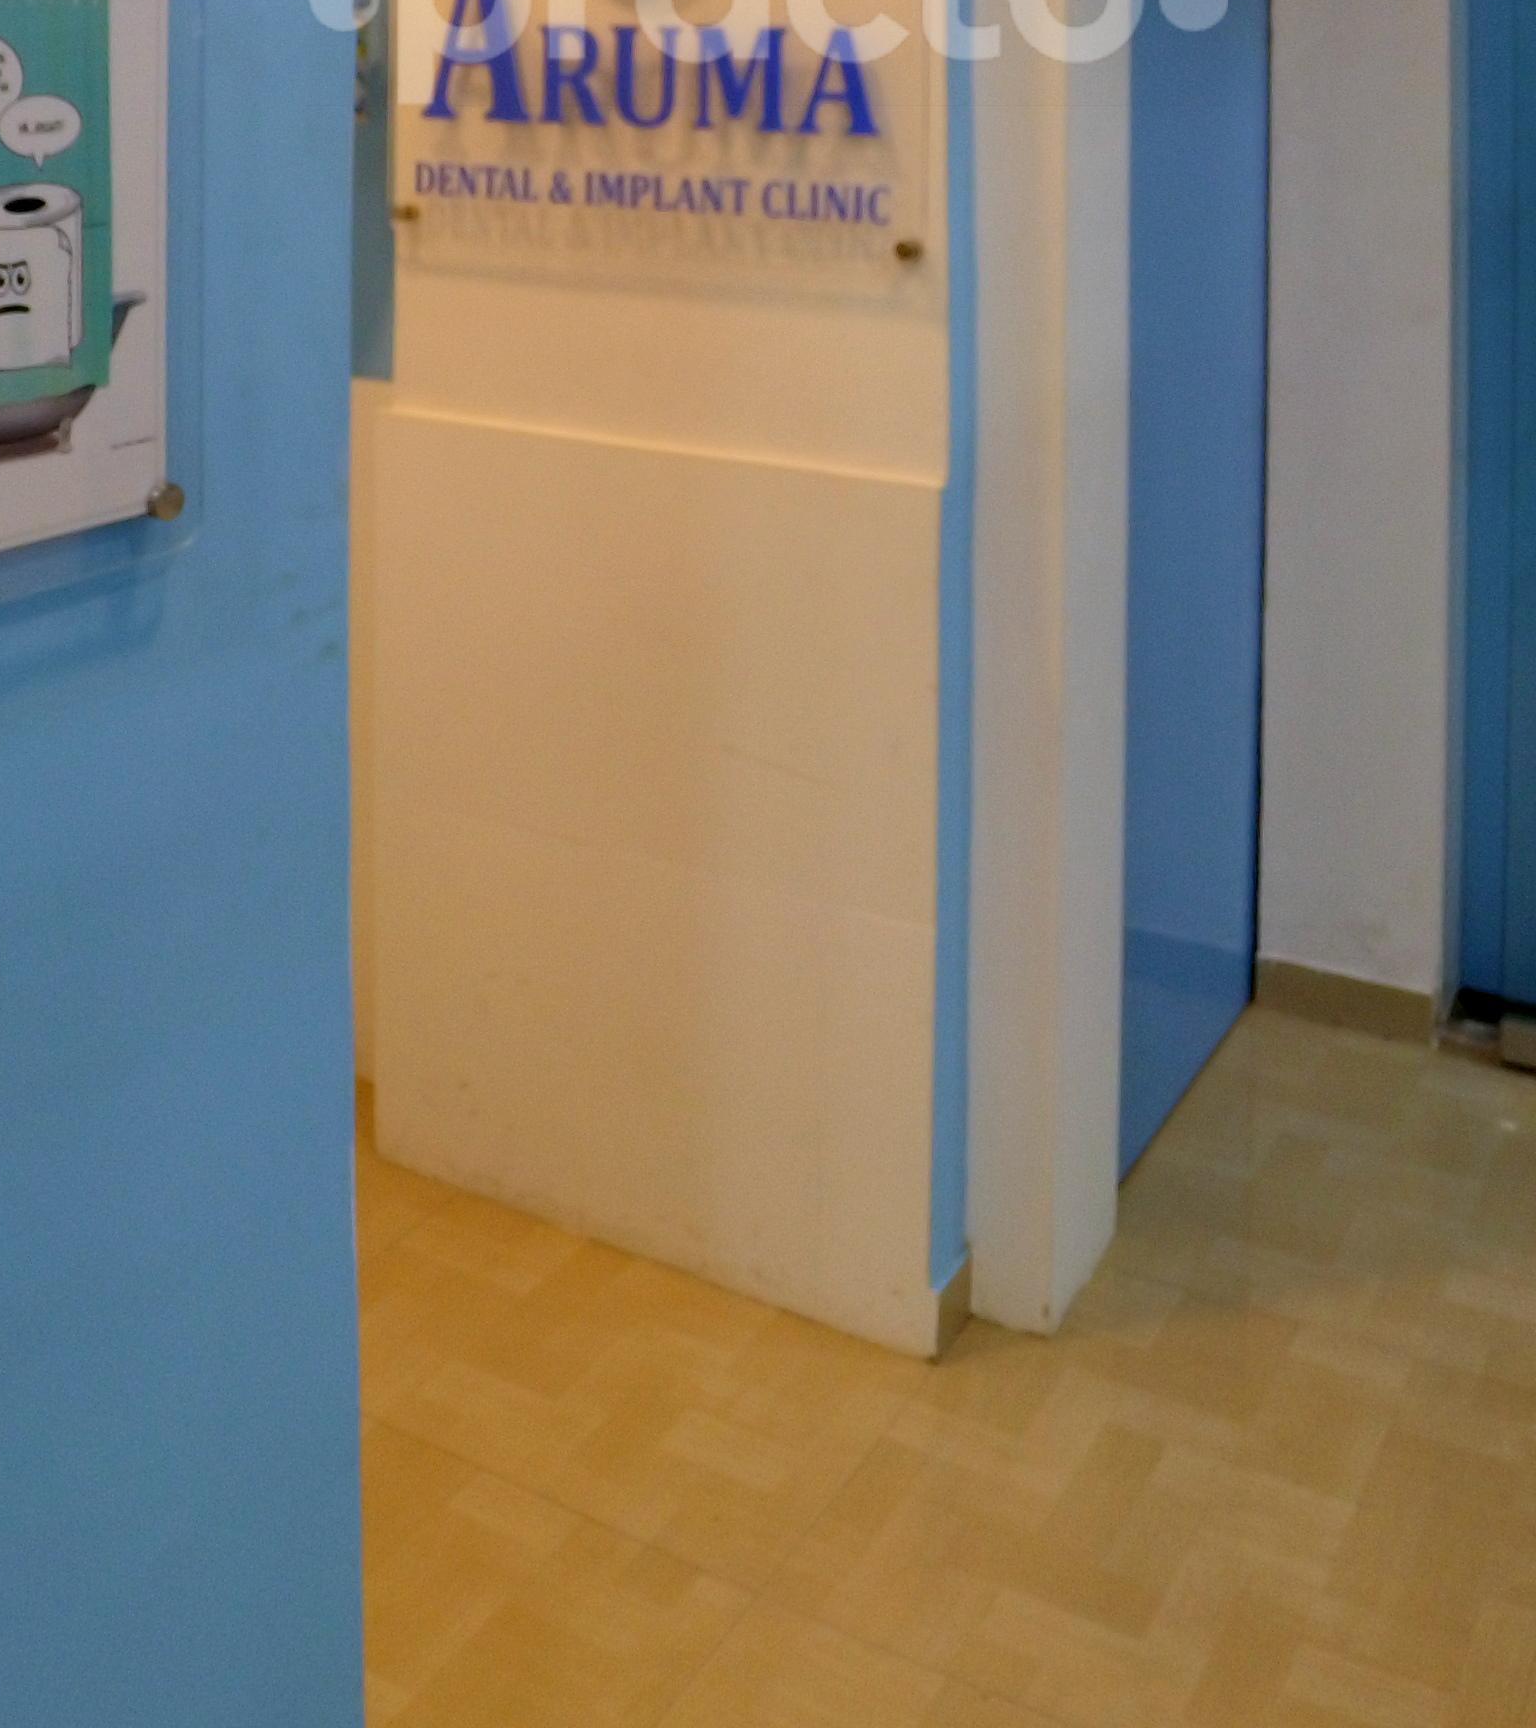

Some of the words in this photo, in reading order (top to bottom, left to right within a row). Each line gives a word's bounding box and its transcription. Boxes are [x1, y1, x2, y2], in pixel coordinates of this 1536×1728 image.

[414, 159, 539, 204] DENTAL
[548, 171, 574, 206] &
[584, 173, 750, 219] IMPLANT
[762, 179, 892, 227] CLINIC
